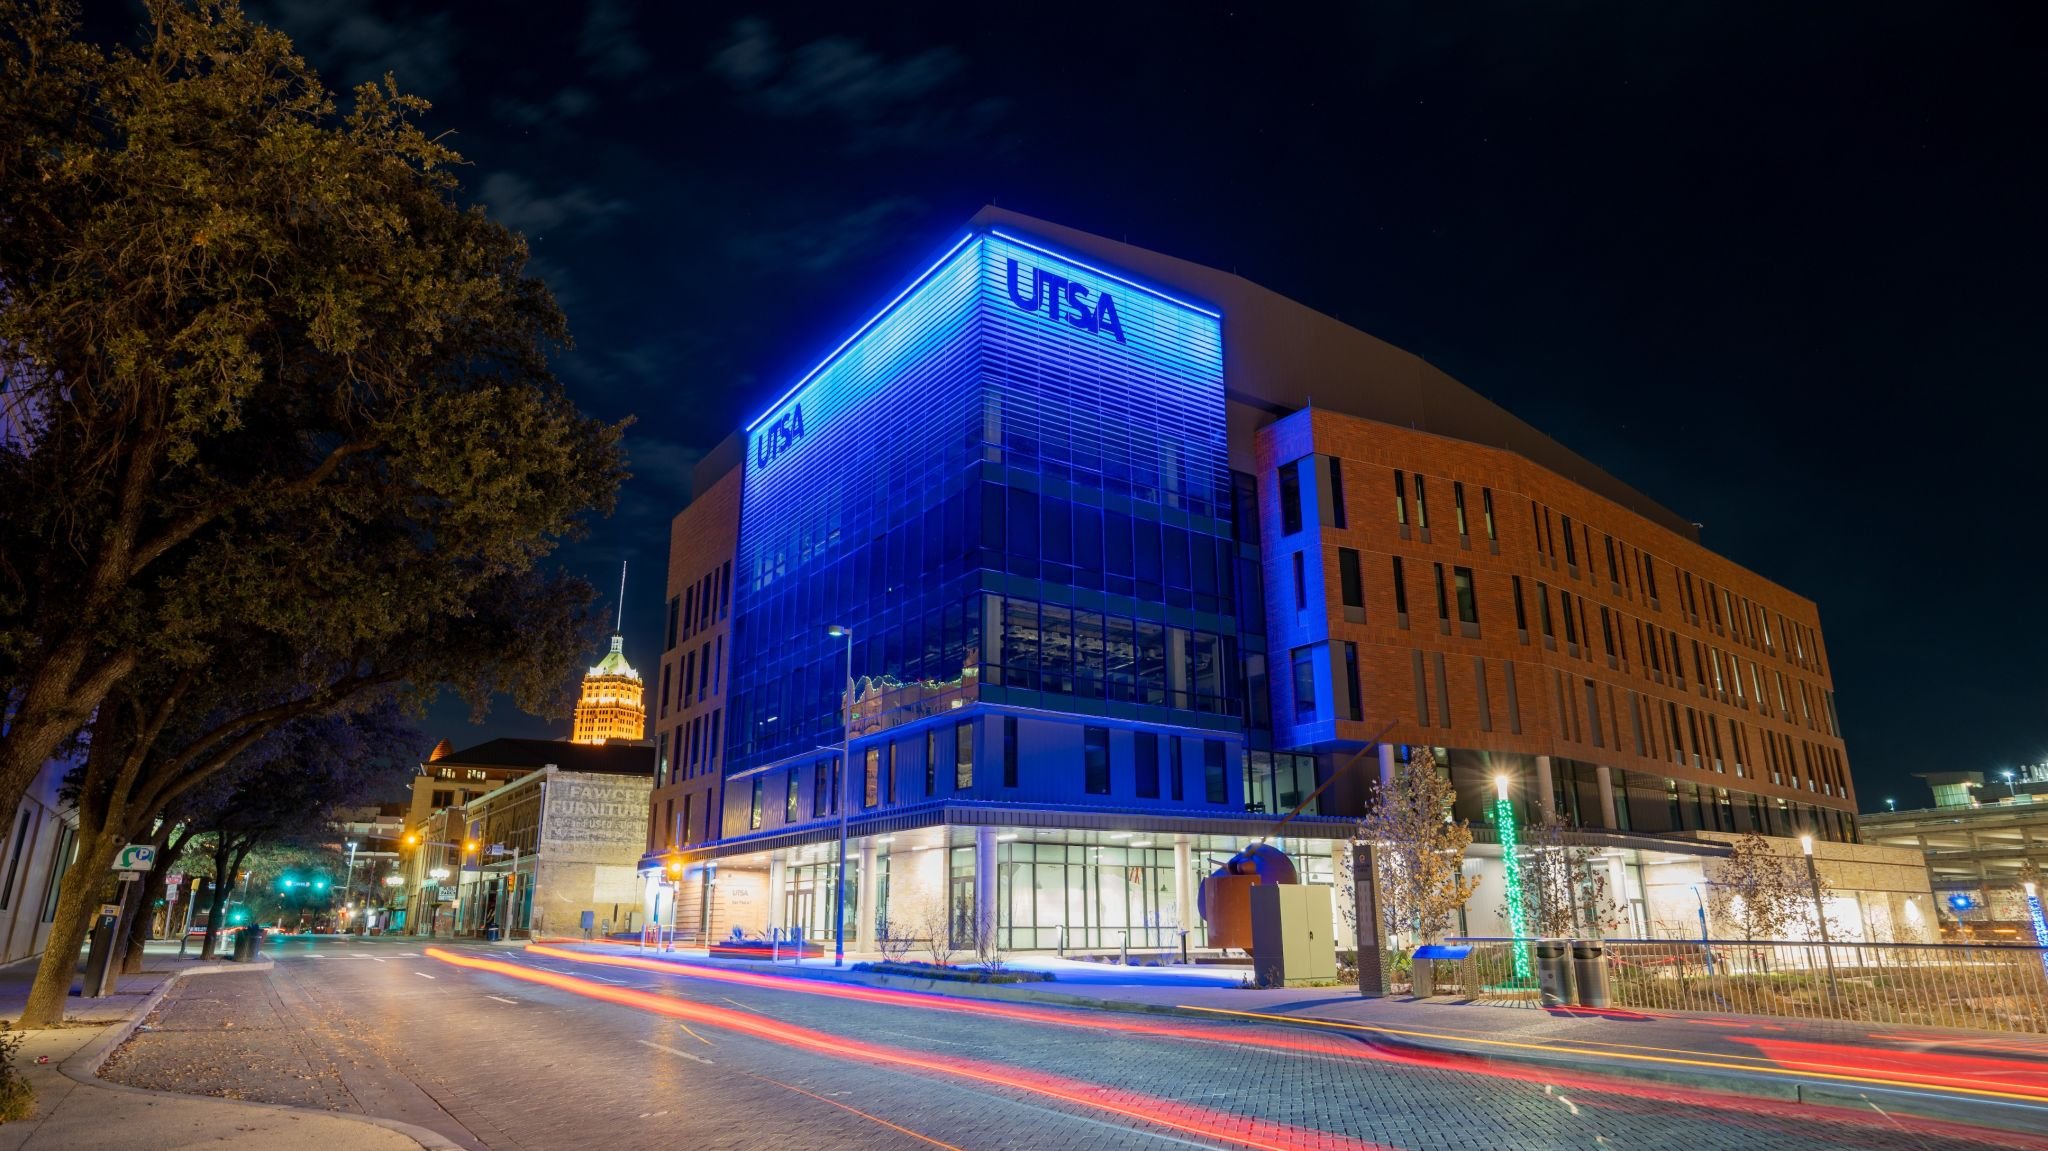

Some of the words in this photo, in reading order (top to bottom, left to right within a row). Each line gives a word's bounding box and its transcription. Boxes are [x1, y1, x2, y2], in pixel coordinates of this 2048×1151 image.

[1007, 257, 1126, 345] UTSA
[758, 402, 804, 468] UTSA
[551, 800, 649, 818] FURNITURE
[139, 849, 150, 859] P
[105, 916, 113, 925] P
